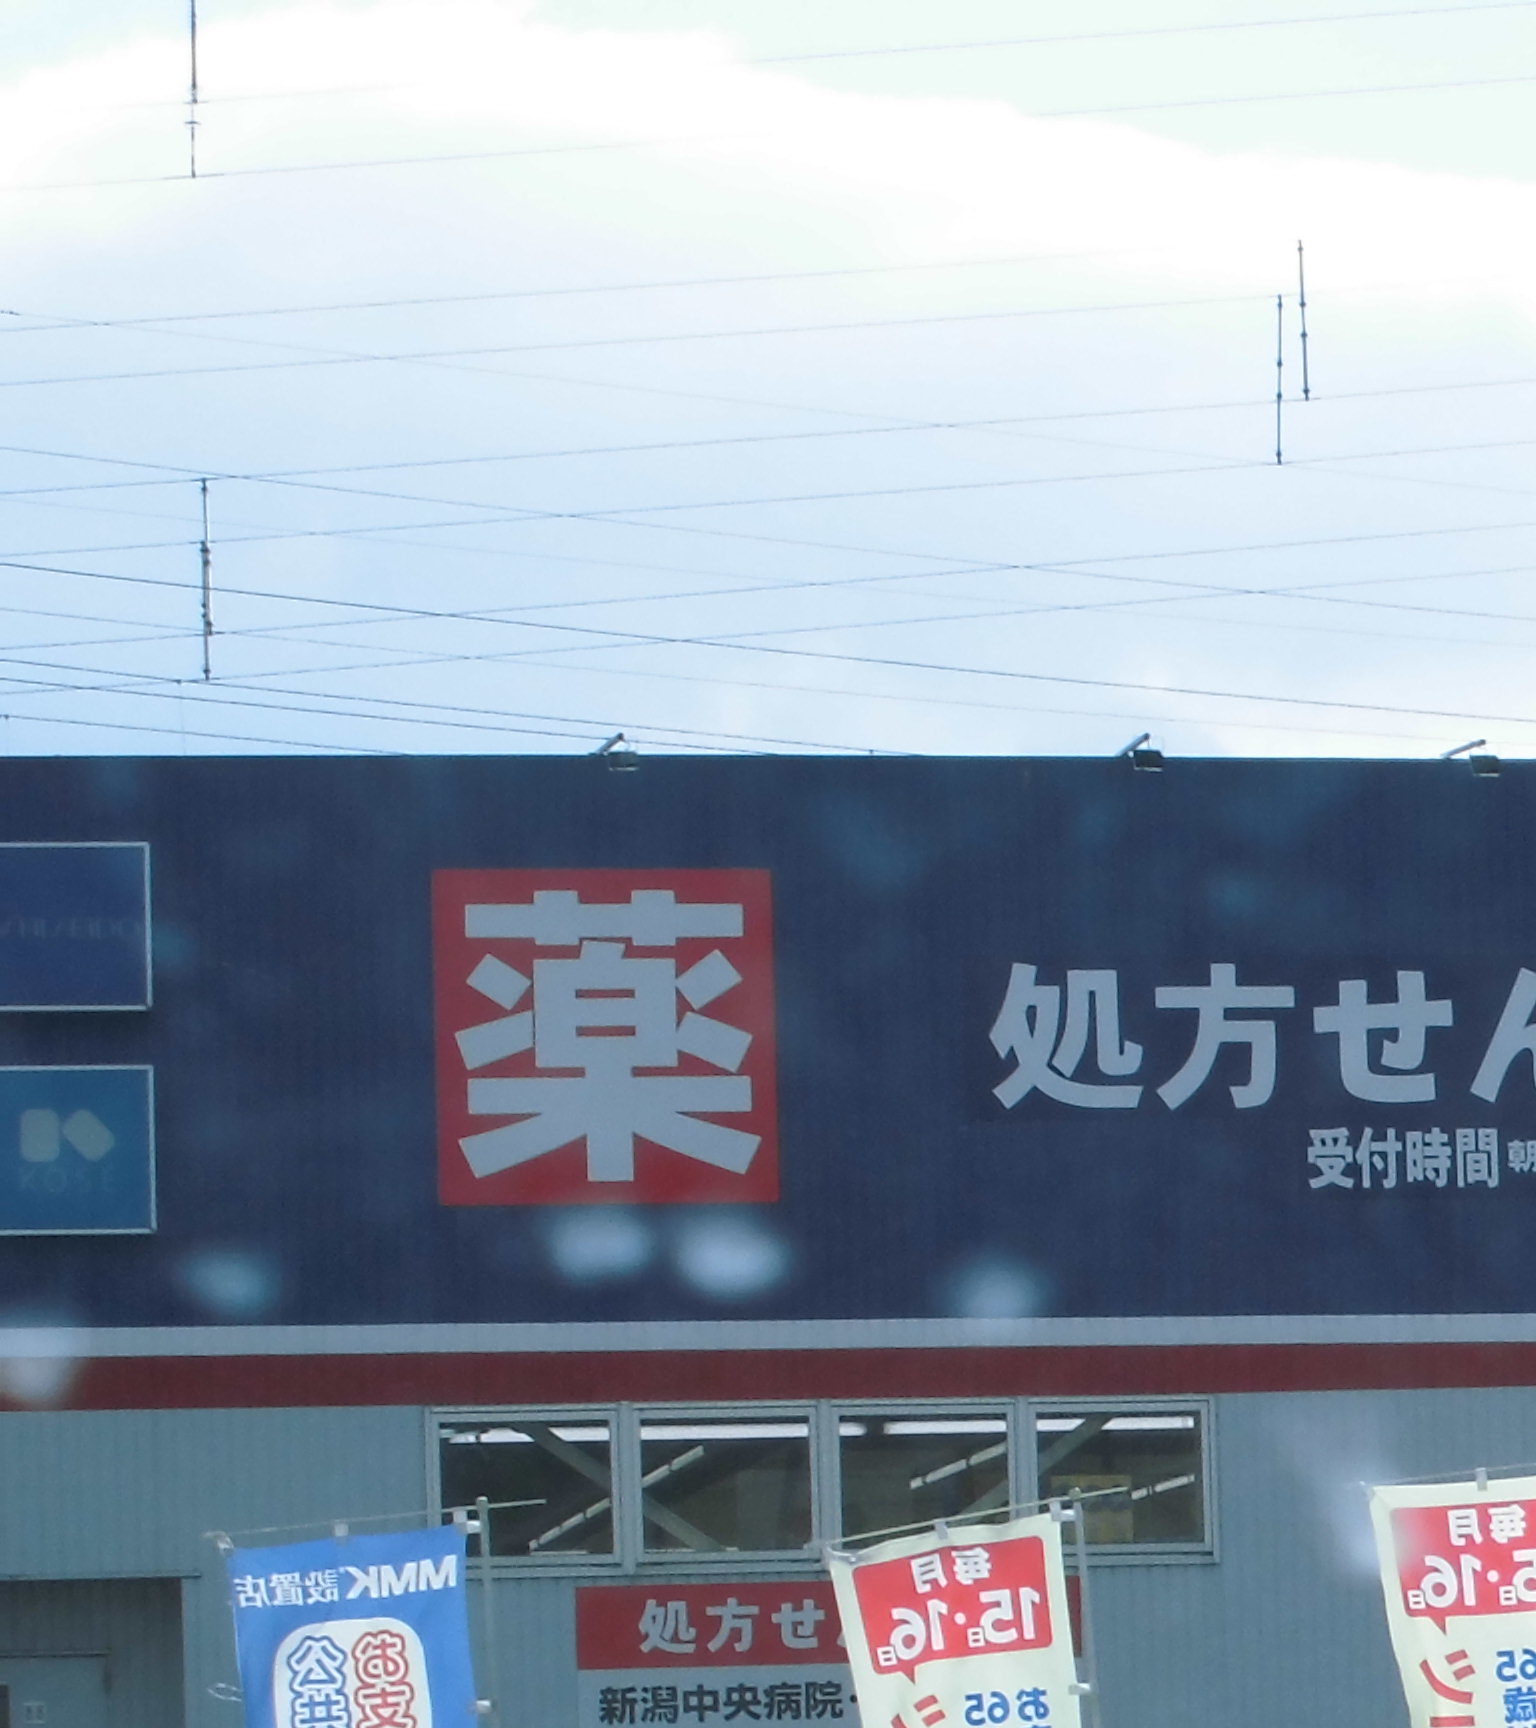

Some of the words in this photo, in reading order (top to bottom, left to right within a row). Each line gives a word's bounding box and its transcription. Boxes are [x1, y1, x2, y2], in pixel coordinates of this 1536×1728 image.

[455, 889, 761, 1181] 薬
[637, 1596, 848, 1654] 処方せ
